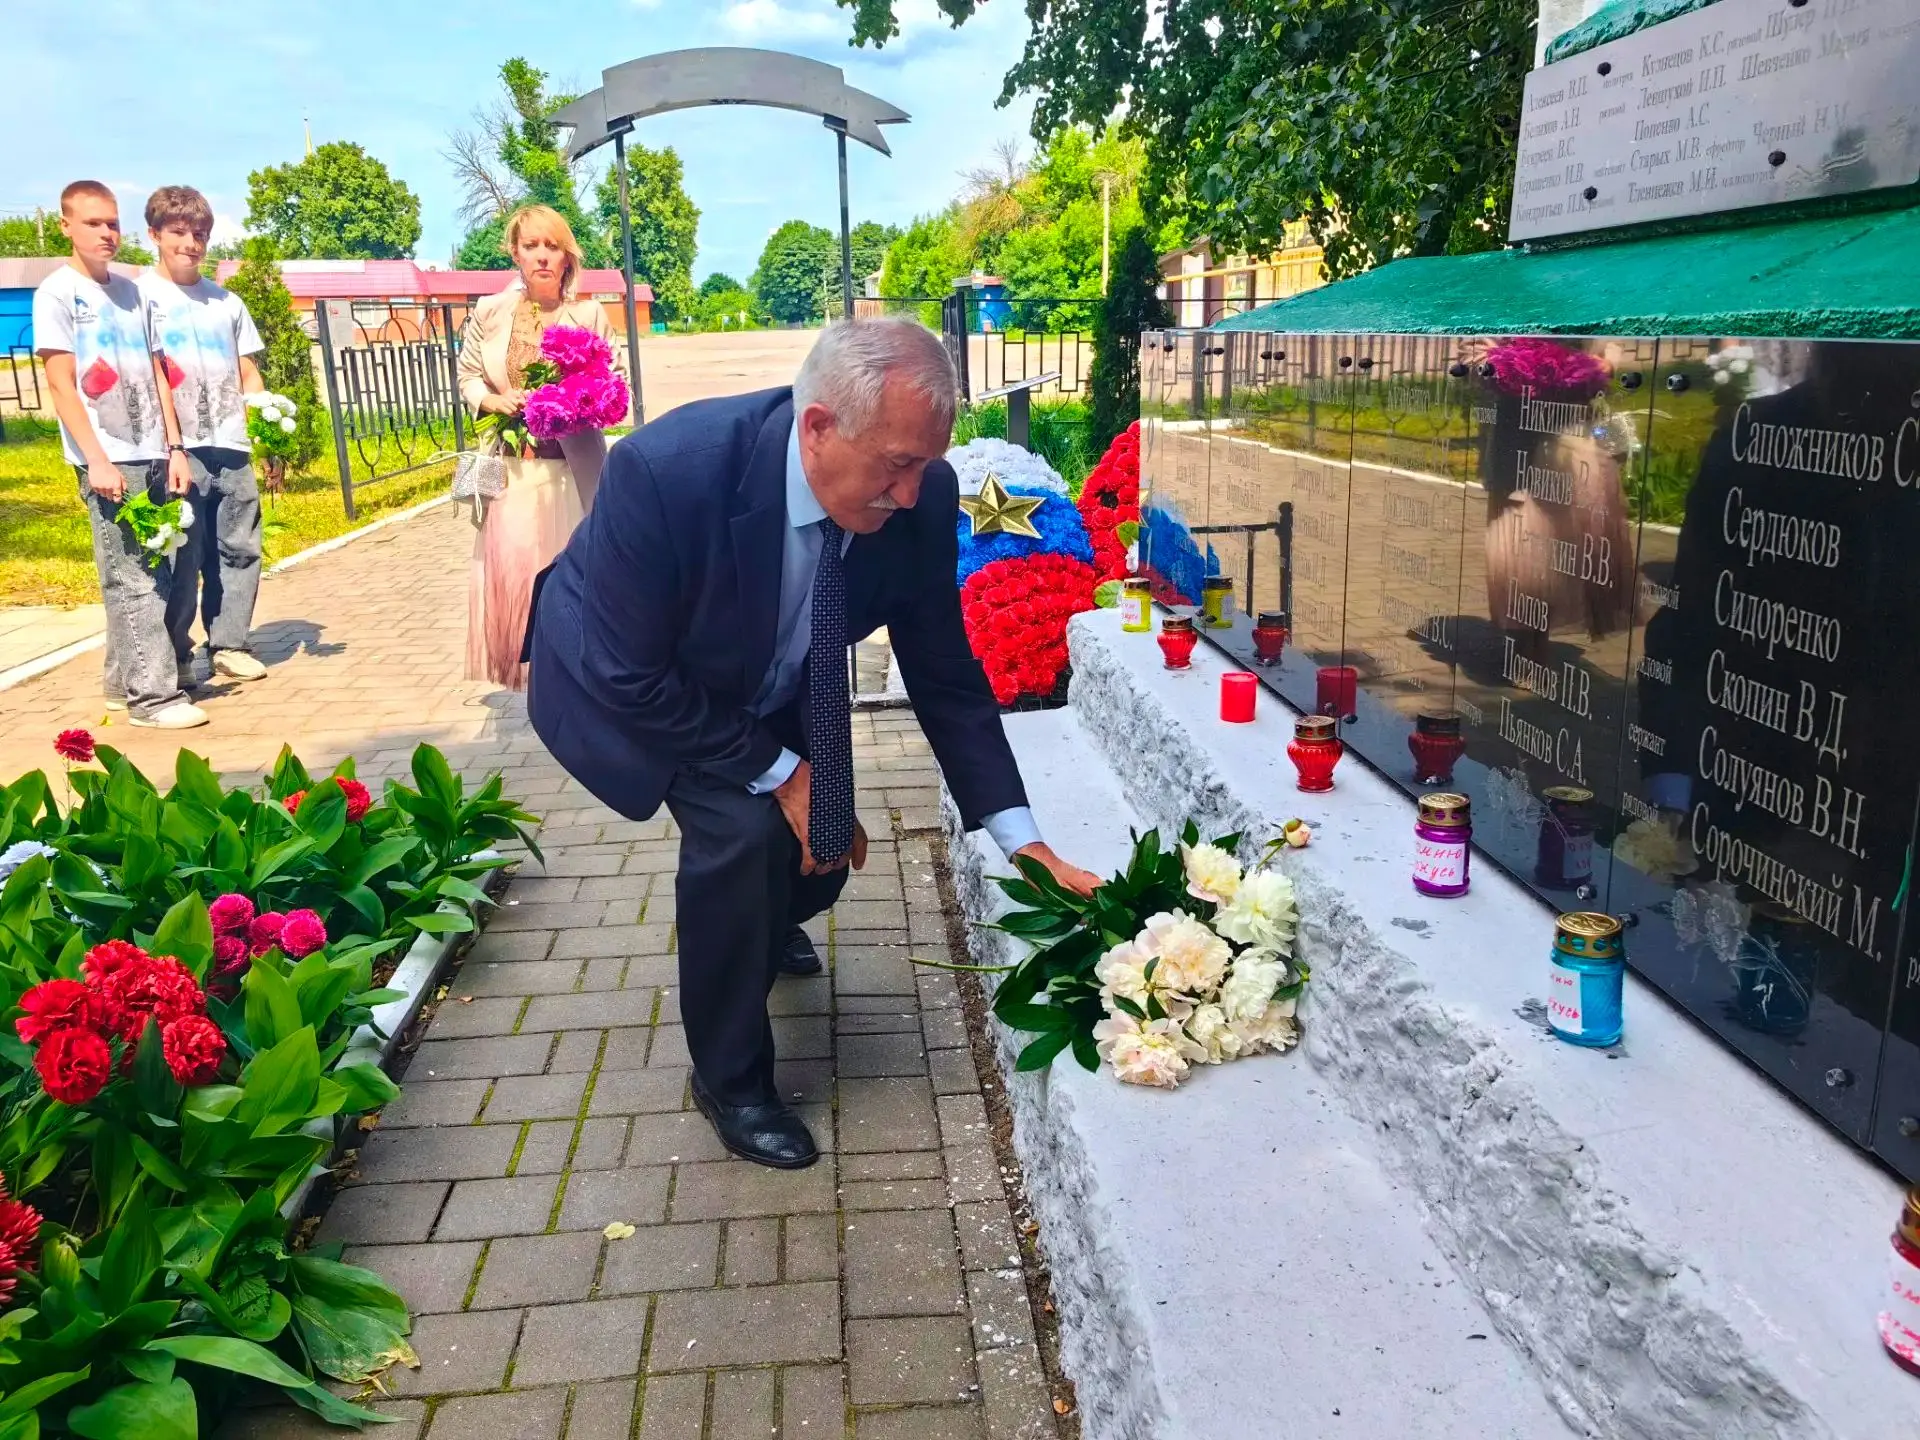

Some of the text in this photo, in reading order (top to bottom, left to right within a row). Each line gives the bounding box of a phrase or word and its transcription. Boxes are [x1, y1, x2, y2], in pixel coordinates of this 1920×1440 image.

[1641, 48, 1693, 81] Кузнецов
[1698, 31, 1724, 60] К.С.
[1737, 48, 1811, 81] Шевченко
[1631, 149, 1671, 174] Старых
[1518, 384, 1588, 437] Никишин
[1732, 402, 1885, 482] Сапожников
[1515, 450, 1573, 506] Новиков
[1580, 532, 1613, 588] В.В.
[1723, 486, 1841, 568] Сердюков
[1506, 576, 1549, 632] Попов
[1715, 569, 1841, 662] Сидоренко
[1502, 635, 1592, 721] Потапов П.В.
[1706, 649, 1791, 734] Скопин
[1793, 680, 1848, 772] В.Д.
[1498, 695, 1553, 764] Пьянков
[1556, 727, 1587, 786] С.А.
[1628, 723, 1866, 860] сержант Солуянов В.Н.
[1621, 791, 1882, 962] рядовой Сорочинский М.
